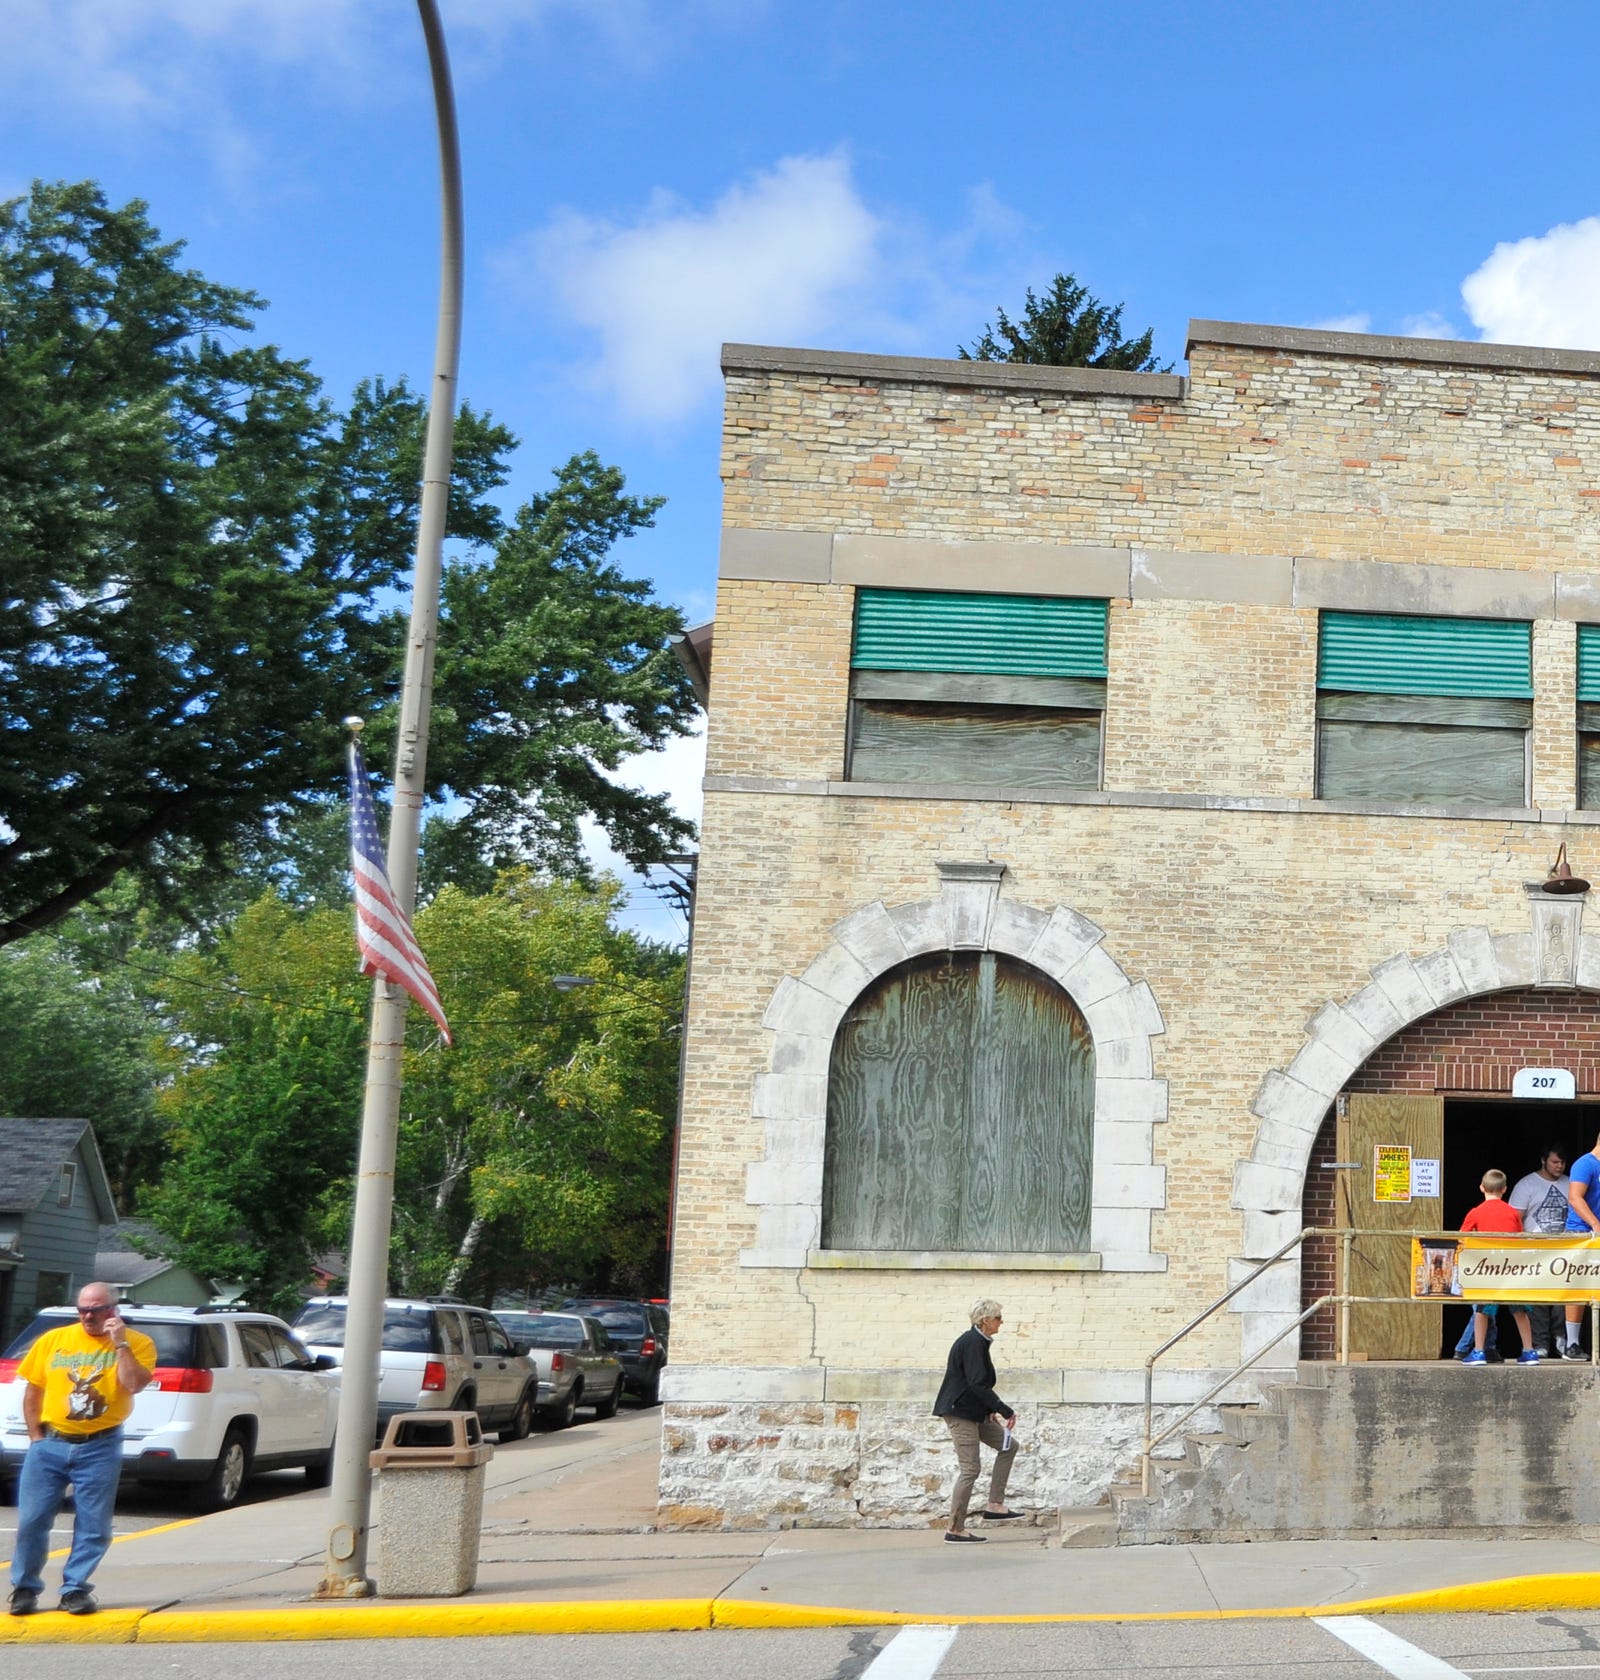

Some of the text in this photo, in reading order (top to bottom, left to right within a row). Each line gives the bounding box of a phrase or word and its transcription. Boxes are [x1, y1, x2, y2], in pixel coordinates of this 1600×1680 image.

[1532, 1077, 1556, 1088] 207
[1379, 1153, 1409, 1162] AMHERST
[1463, 1257, 1542, 1277] Amherst
[1549, 1257, 1600, 1283] Opera
